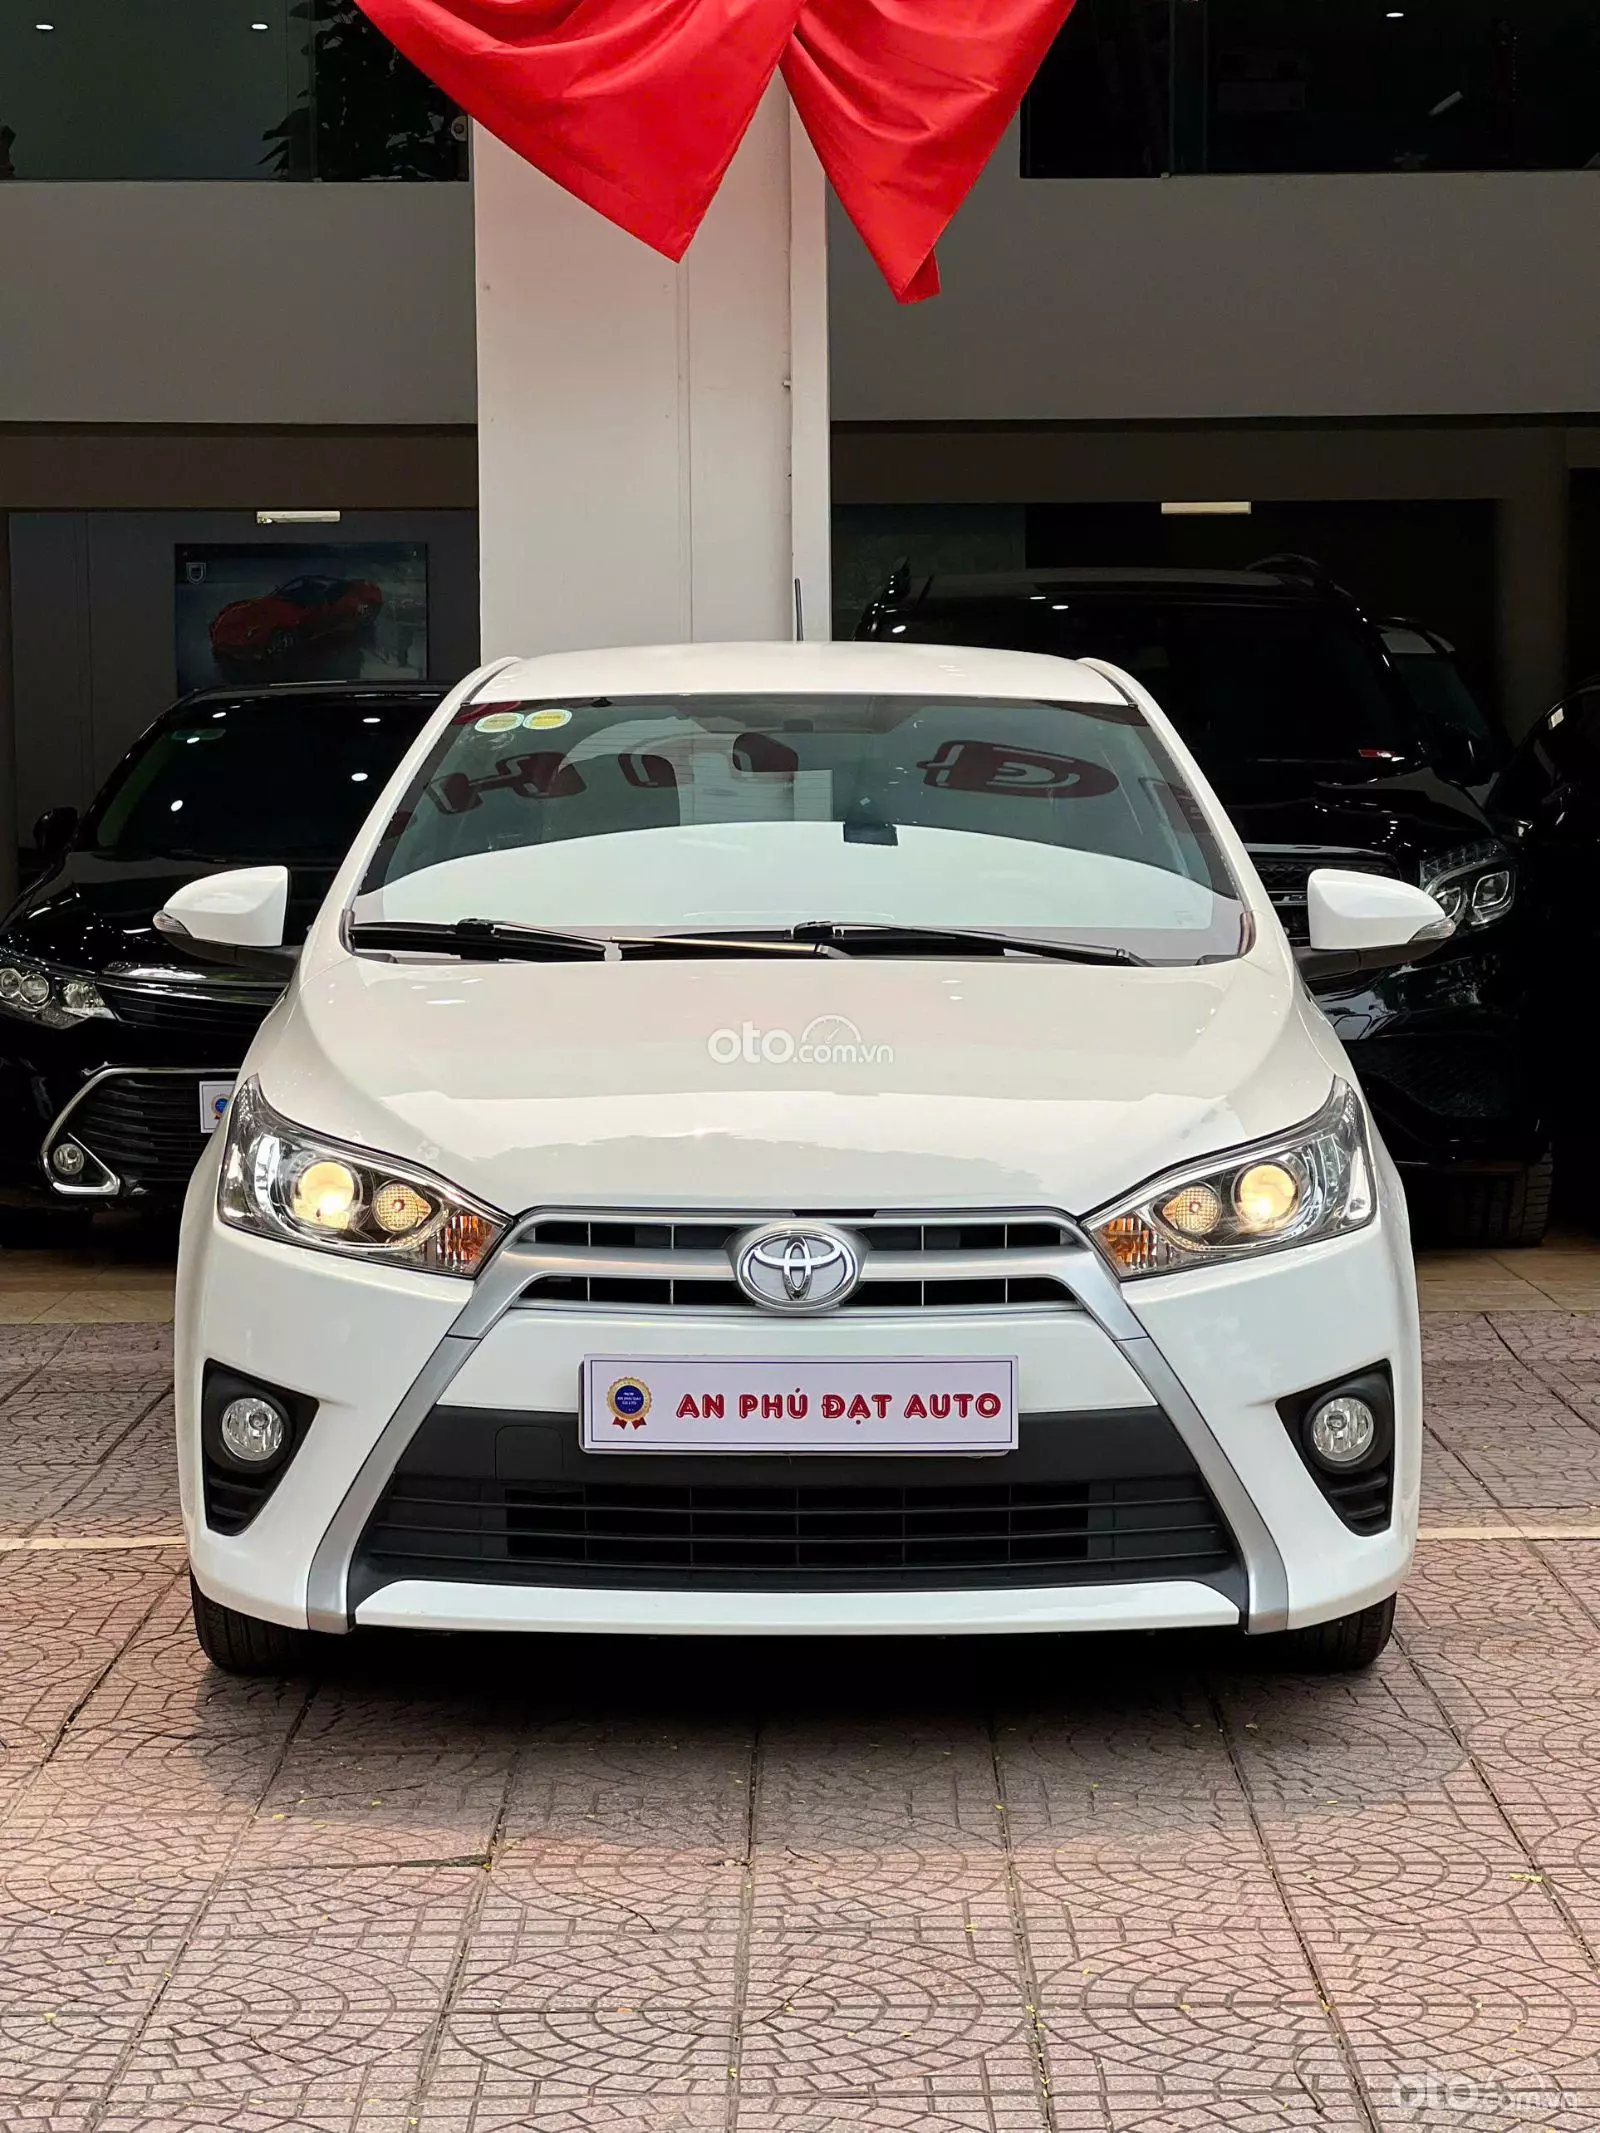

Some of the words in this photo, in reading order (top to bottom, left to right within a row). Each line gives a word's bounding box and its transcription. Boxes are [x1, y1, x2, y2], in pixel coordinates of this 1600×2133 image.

[676, 1393, 725, 1419] AN
[739, 1387, 808, 1419] PHÚ
[821, 1393, 892, 1425] ĐẠT
[903, 1393, 1002, 1418] AUTO
